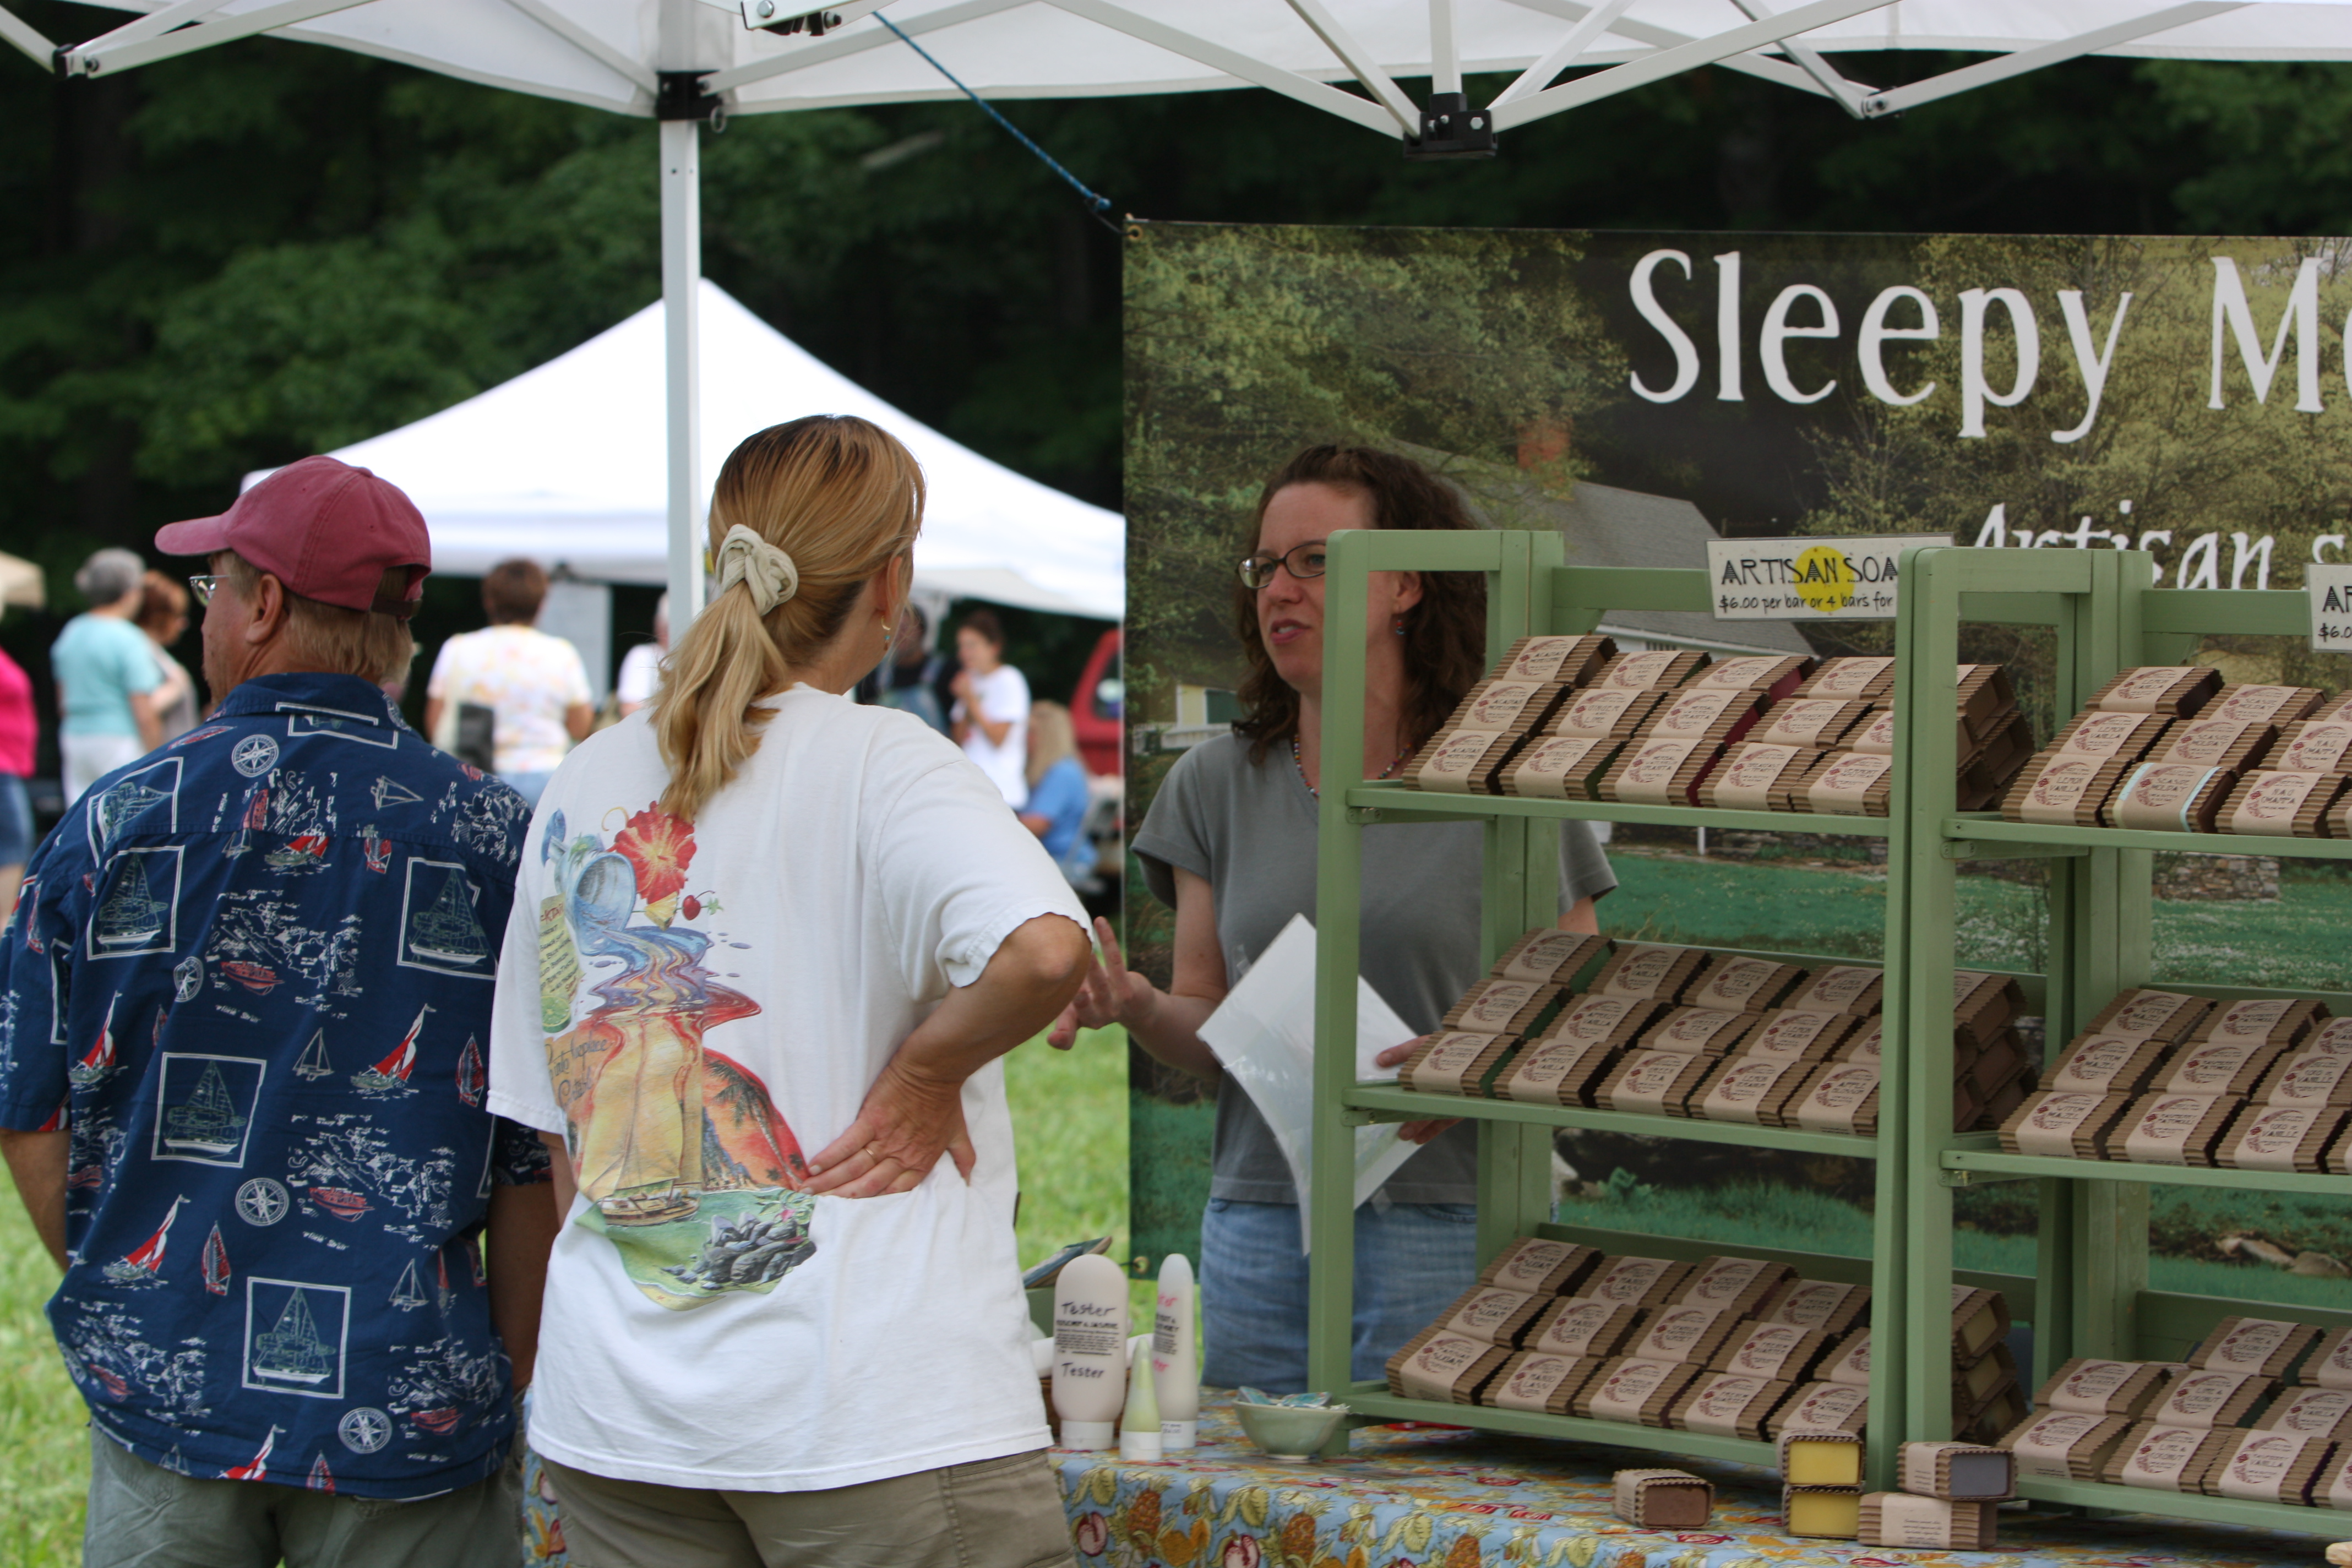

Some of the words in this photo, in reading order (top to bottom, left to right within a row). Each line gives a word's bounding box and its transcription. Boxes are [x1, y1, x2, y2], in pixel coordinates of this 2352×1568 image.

[1629, 248, 2133, 443] Sleepy
[2207, 255, 2352, 413] M
[1721, 558, 1839, 585] ARTISAN
[1843, 556, 1898, 582] SOA
[1719, 595, 1758, 613] $6.00
[1762, 596, 1781, 614] per
[1784, 594, 1805, 608] bar
[1810, 597, 1823, 608] or
[1842, 592, 1869, 607] bars
[1873, 591, 1893, 611] for
[2318, 623, 2352, 642] $6.0
[1061, 1301, 1117, 1316] Tester
[1061, 1362, 1105, 1378] Tester
